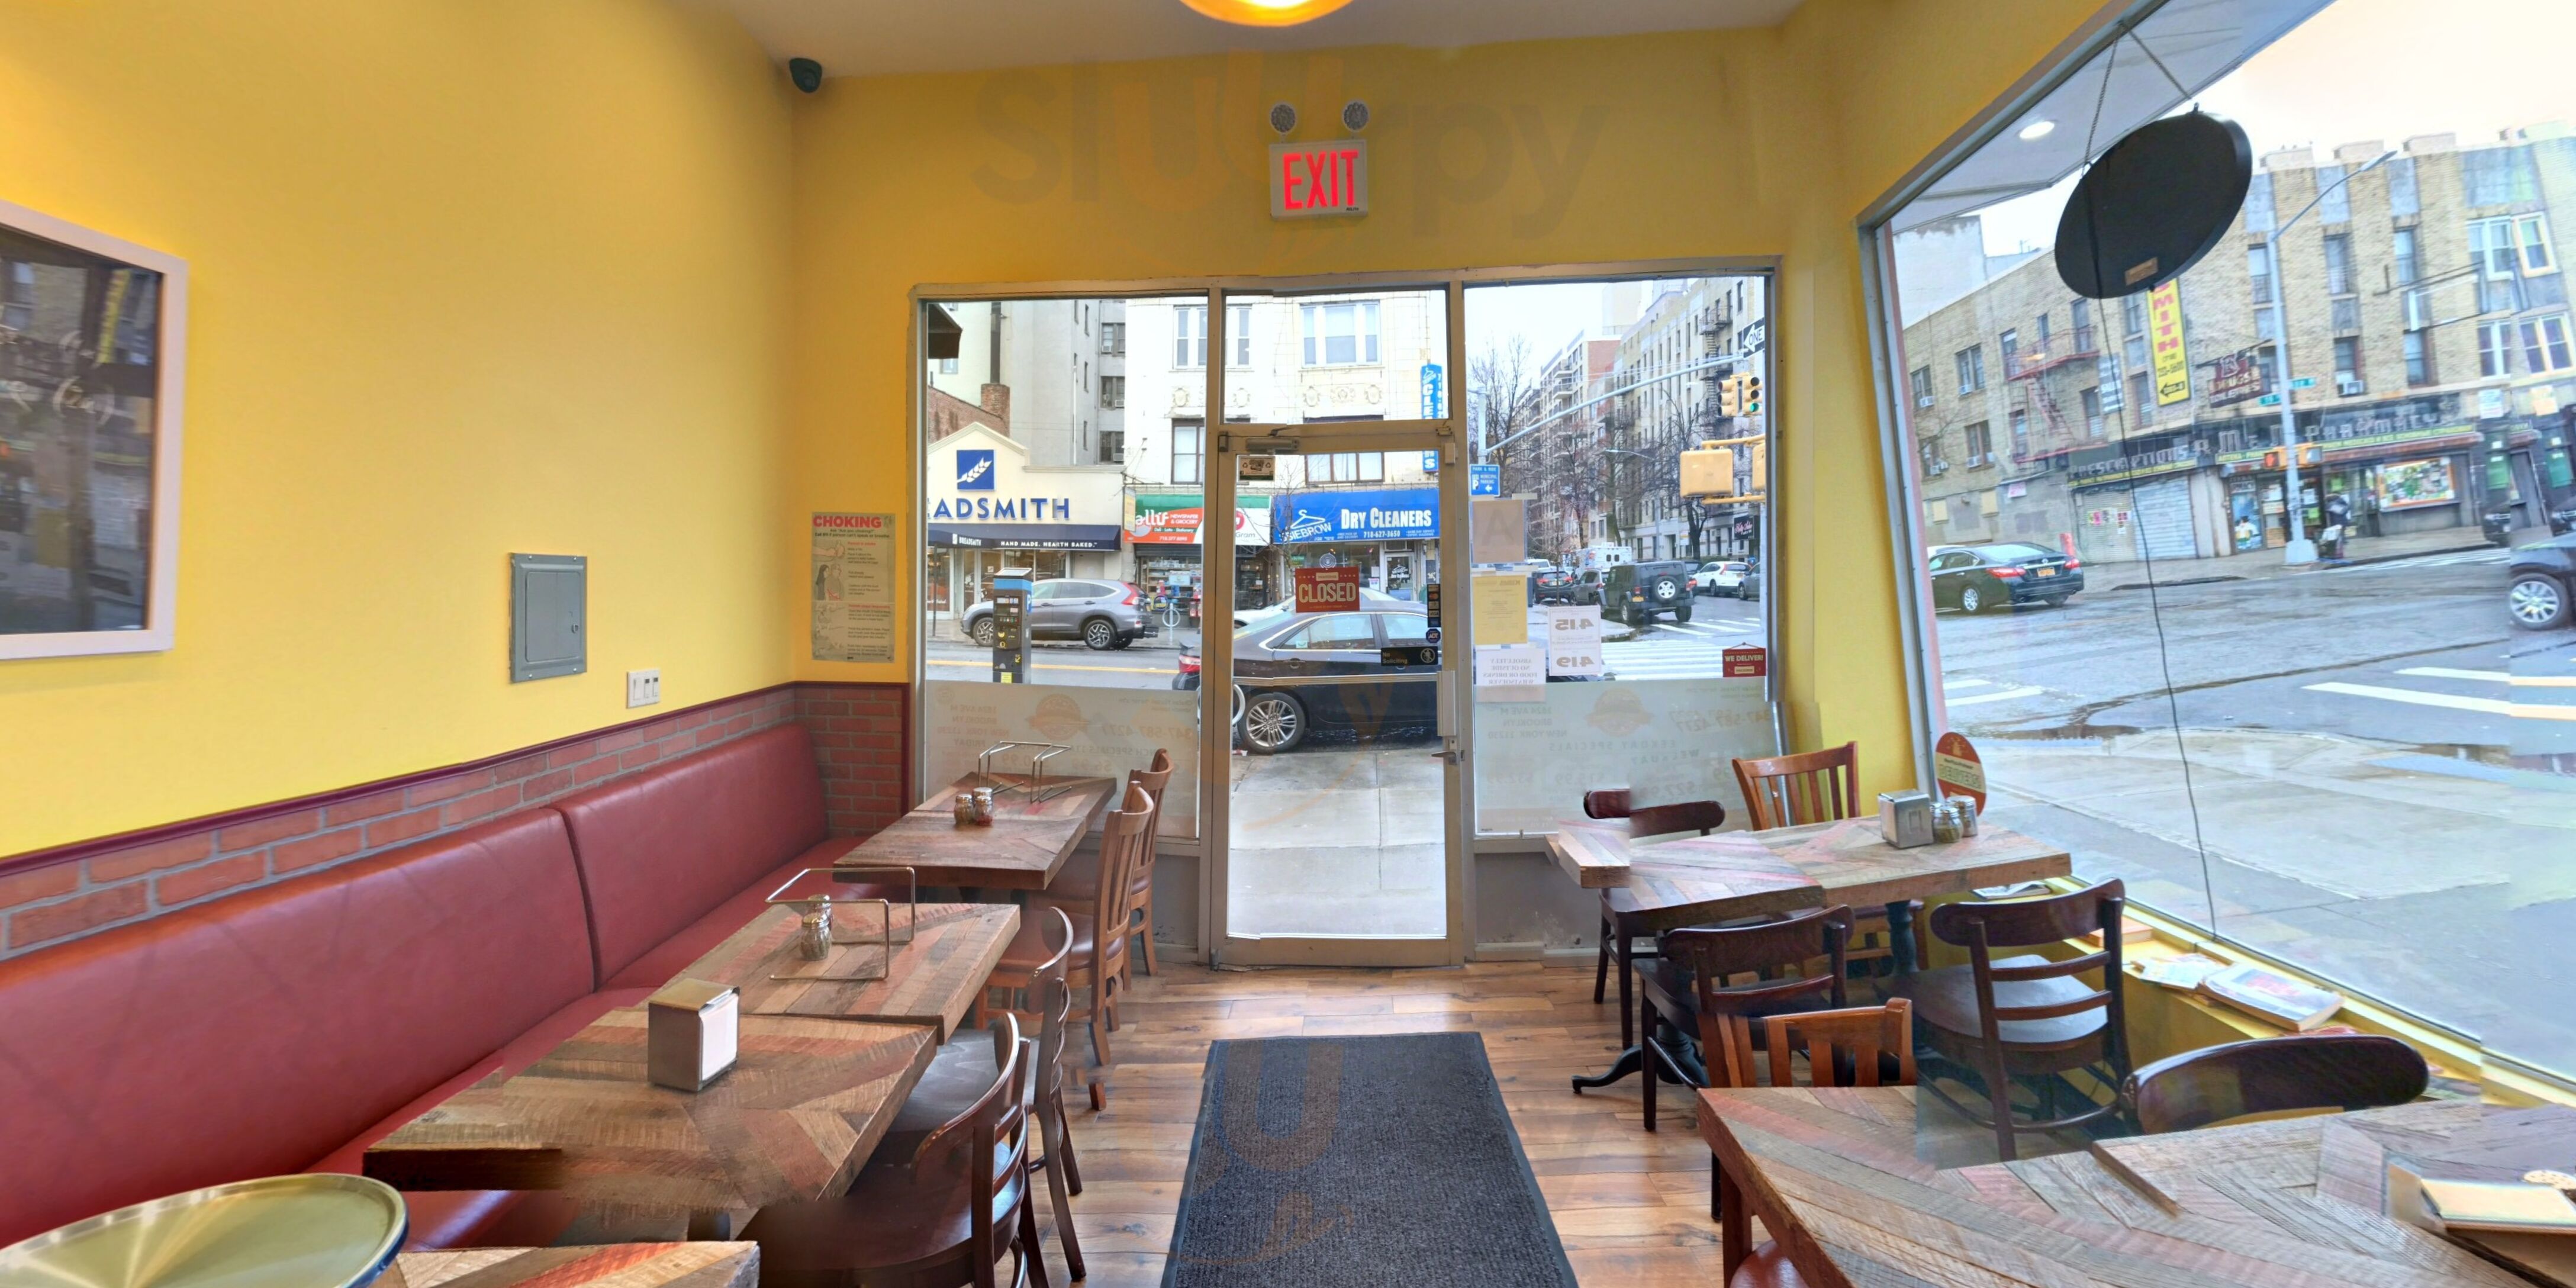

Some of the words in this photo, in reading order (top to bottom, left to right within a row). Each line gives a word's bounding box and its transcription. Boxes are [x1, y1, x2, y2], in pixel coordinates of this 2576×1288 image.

[1283, 149, 1359, 210] EXIT
[1749, 329, 1763, 346] ONE
[1473, 479, 1479, 490] P
[928, 498, 1070, 519] ADSMITH
[1341, 509, 1367, 529] DRY
[1370, 507, 1432, 529] CLEANERS
[813, 515, 881, 528] CHOKING
[1027, 594, 1031, 610] P
[1299, 582, 1356, 603] CLOSED
